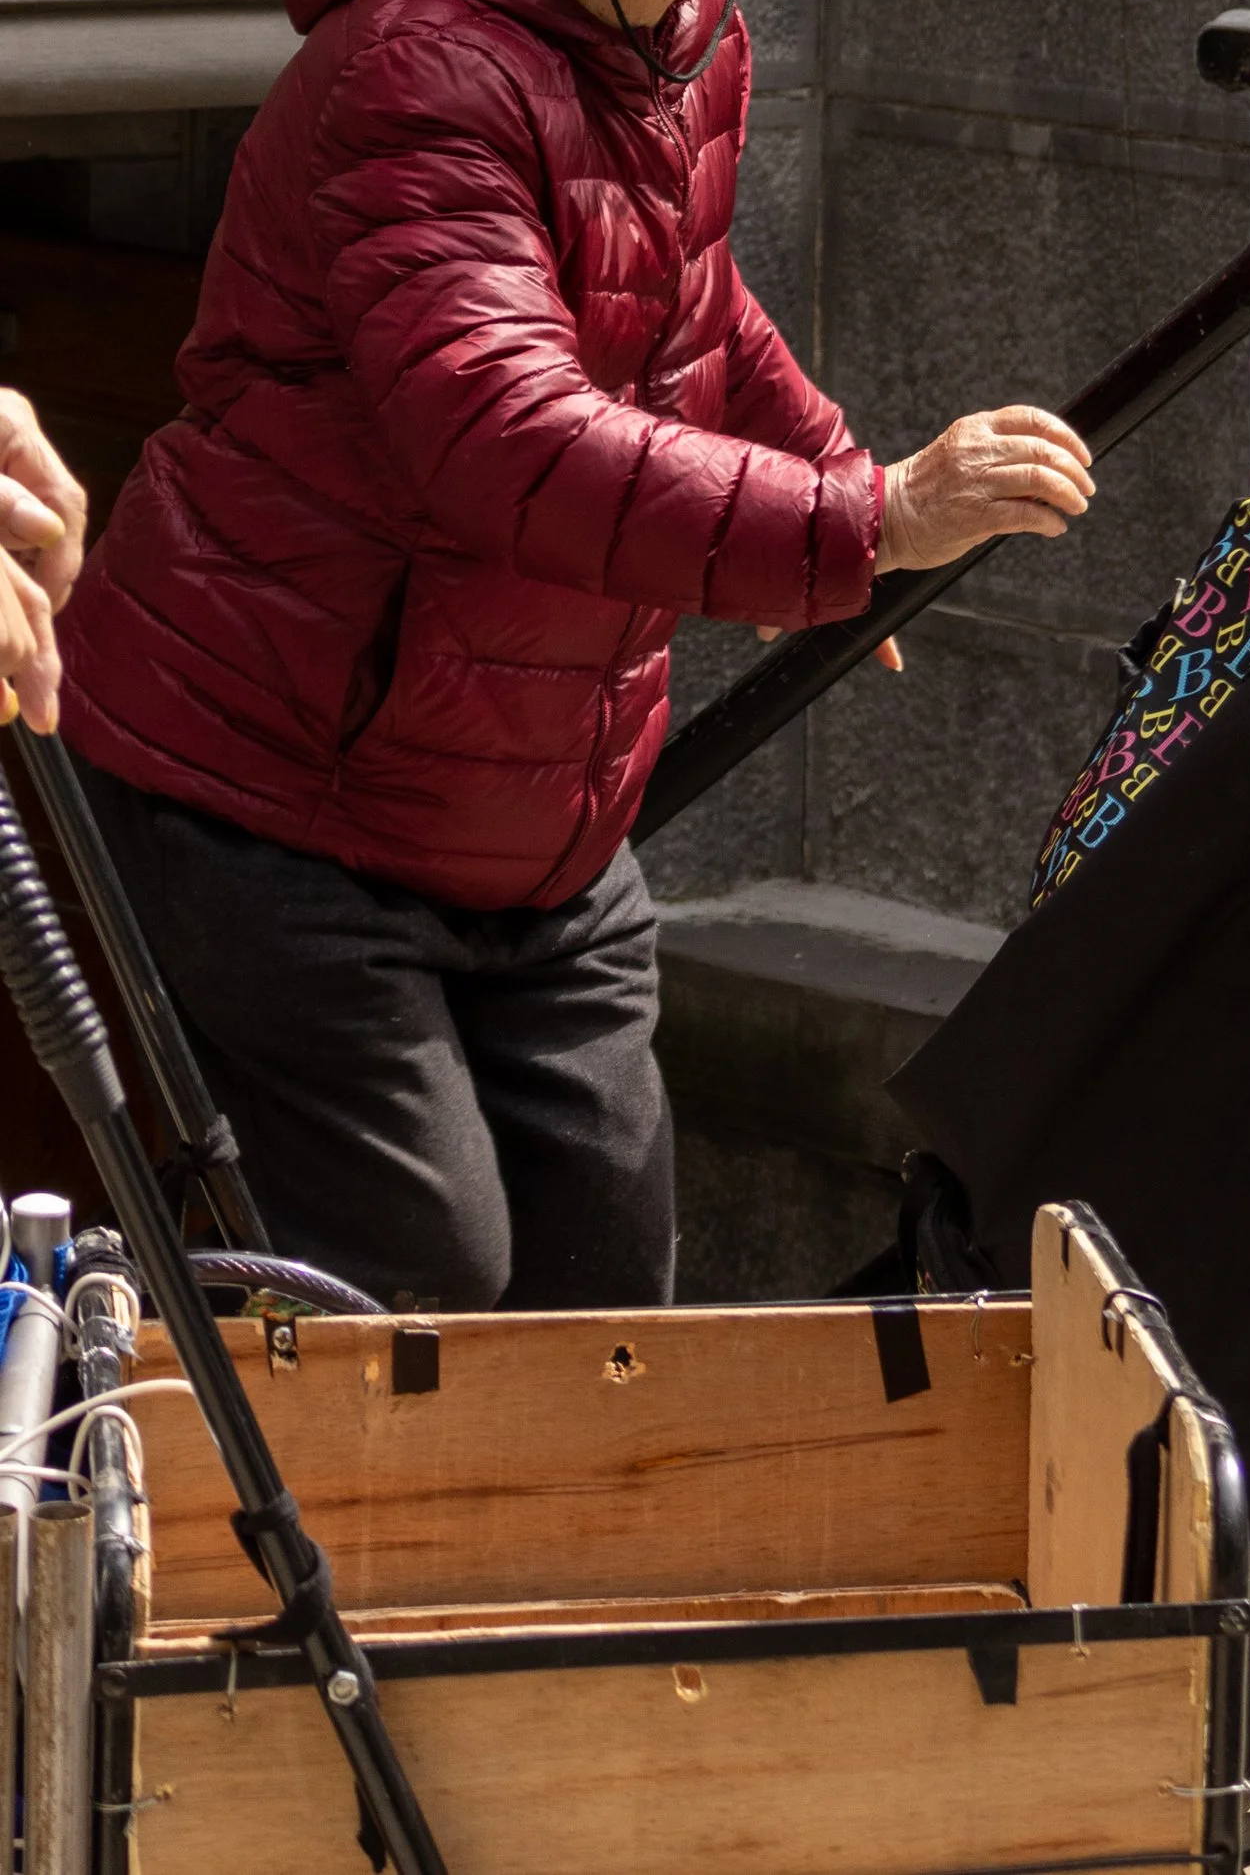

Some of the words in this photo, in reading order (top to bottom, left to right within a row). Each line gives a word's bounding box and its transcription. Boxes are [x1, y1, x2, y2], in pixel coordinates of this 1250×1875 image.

[1174, 581, 1227, 638] B
[1151, 634, 1186, 674] B
[1215, 615, 1248, 654] B
[1168, 648, 1213, 702] B
[1199, 679, 1236, 719] B
[1140, 703, 1177, 739] B
[1094, 731, 1136, 786] B
[1121, 762, 1160, 802] B
[1076, 792, 1126, 848] B
